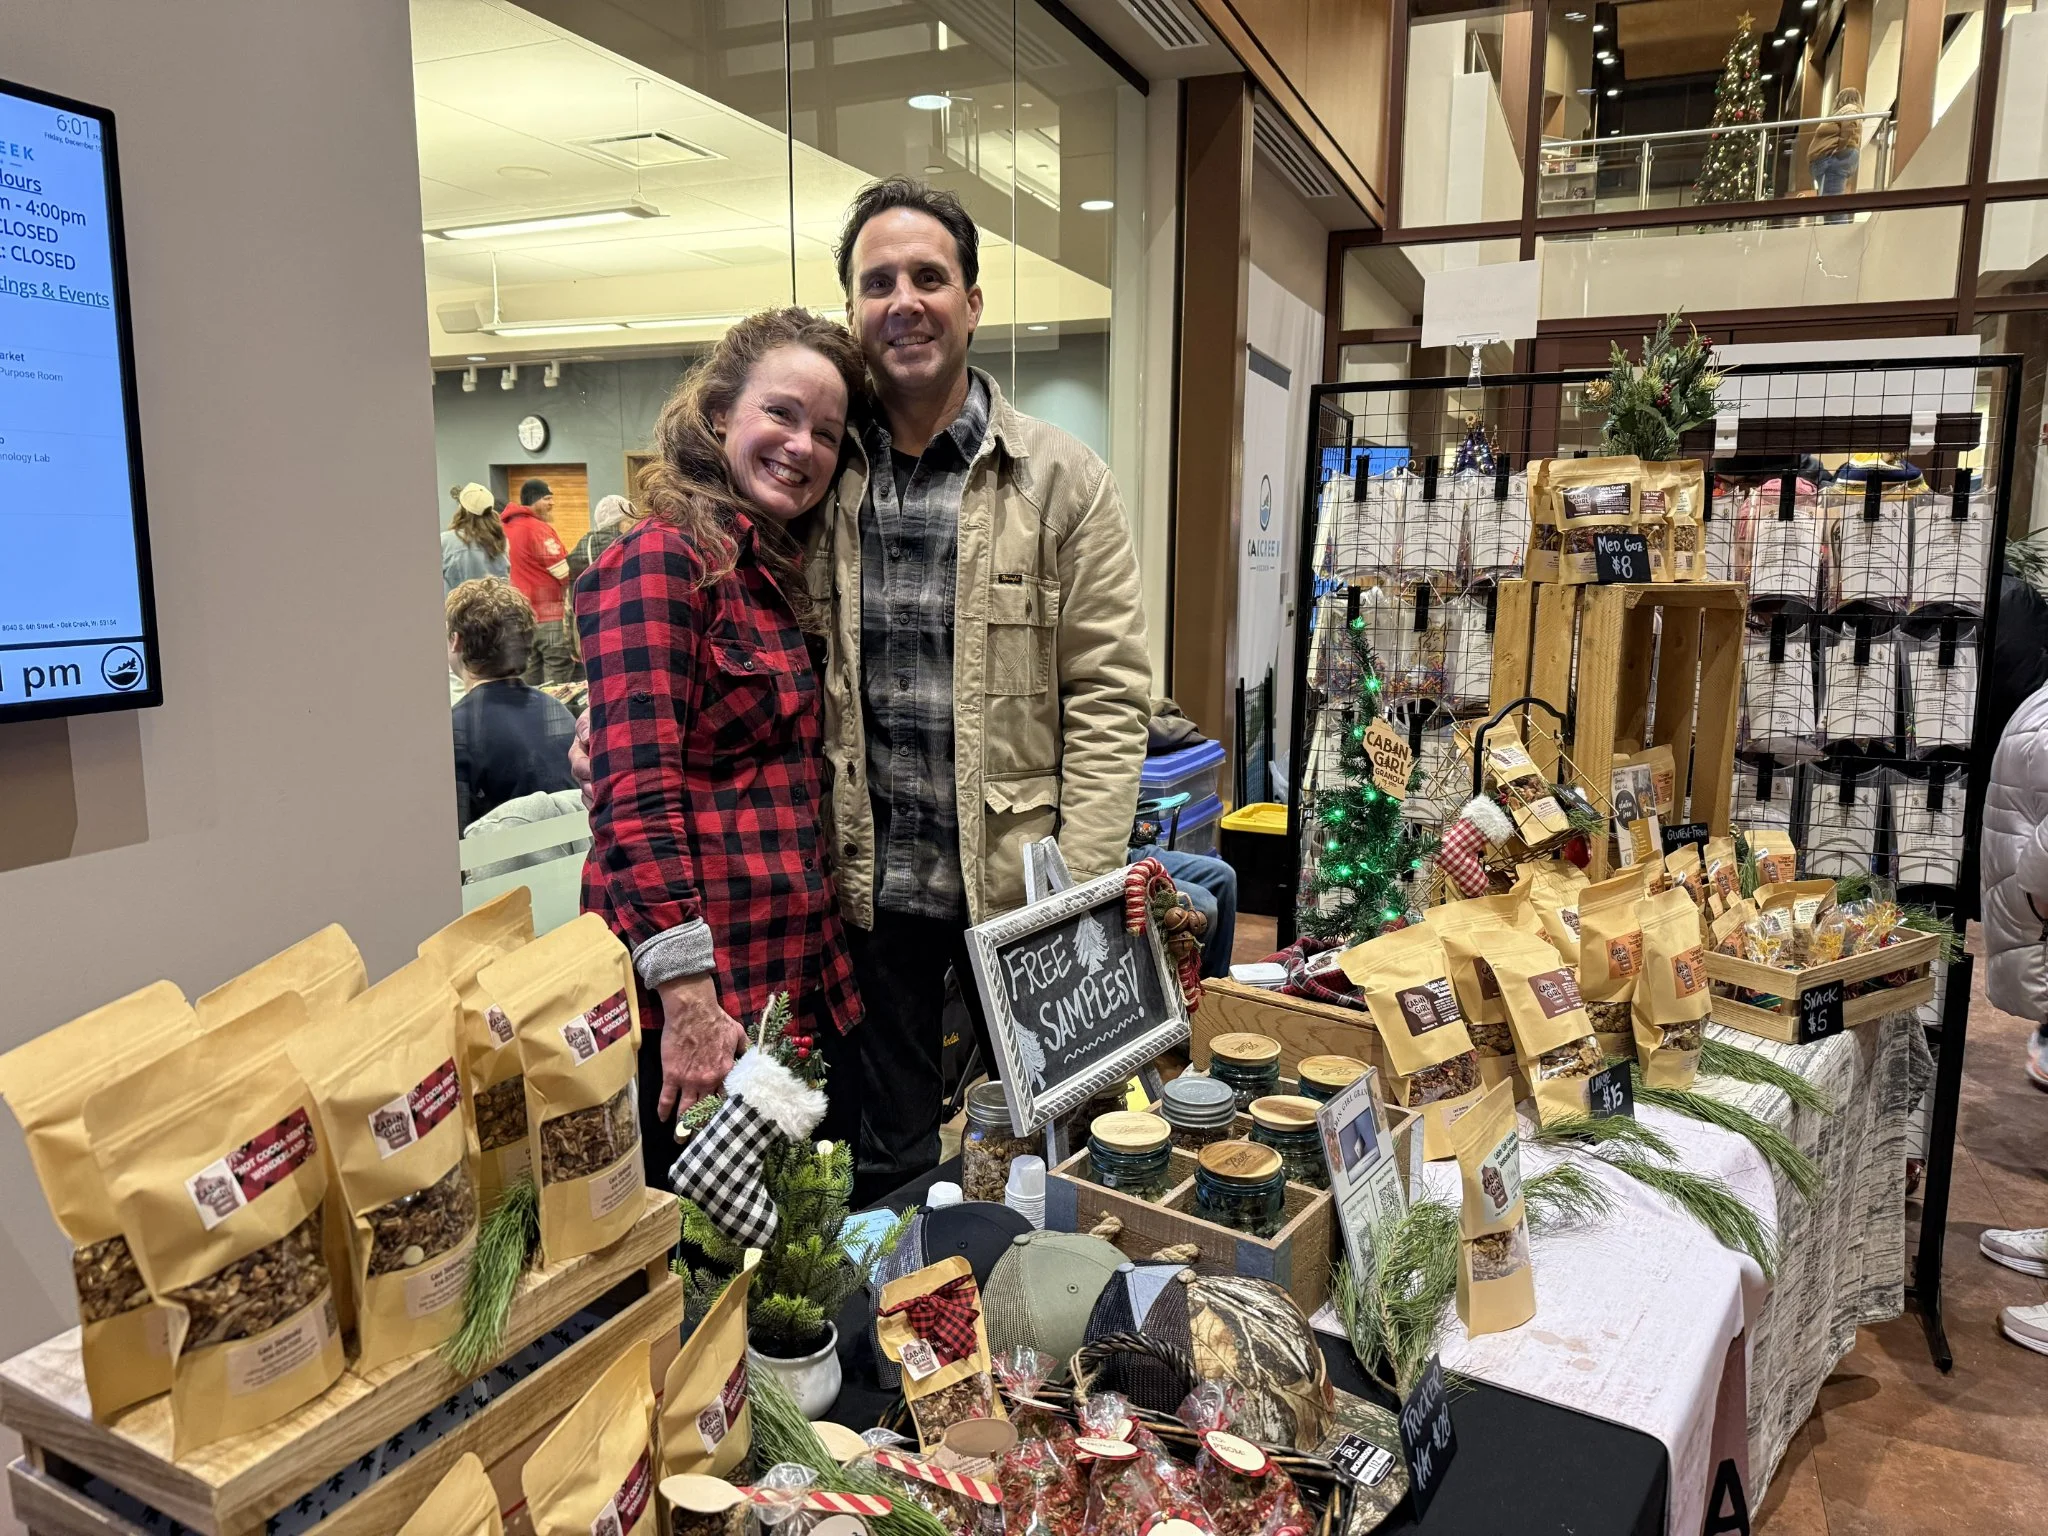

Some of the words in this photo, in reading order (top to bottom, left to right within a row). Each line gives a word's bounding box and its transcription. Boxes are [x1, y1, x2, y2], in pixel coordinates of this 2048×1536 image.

[57, 114, 90, 138] 6:01
[26, 200, 86, 226] 4:00pm
[11, 245, 76, 270] CLOSED
[42, 282, 55, 299] &
[59, 284, 109, 307] Events
[37, 371, 63, 382] Room
[34, 454, 50, 463] Lab
[1611, 555, 1633, 579] $8
[23, 663, 82, 698] pm
[1374, 751, 1406, 776] GIRL
[1375, 767, 1405, 787] GRANOLA
[1002, 933, 1072, 1001] FREE
[1538, 982, 1556, 993] CABIN
[1546, 989, 1562, 998] GIRL
[1803, 986, 1839, 1010] SNACK
[1406, 996, 1426, 1009] CABIN
[1414, 1003, 1430, 1014] GIRL
[1603, 1082, 1624, 1115] $15
[1225, 1150, 1253, 1169] Ball
[1484, 1168, 1500, 1190] CABIN
[1490, 1178, 1505, 1197] GIRL
[905, 1343, 929, 1362] CABIN
[912, 1352, 931, 1368] GIRL
[1401, 1364, 1443, 1447] TRUCKER
[699, 1411, 721, 1431] CABIN
[707, 1420, 724, 1436] GIRL
[1432, 1401, 1452, 1451] $28
